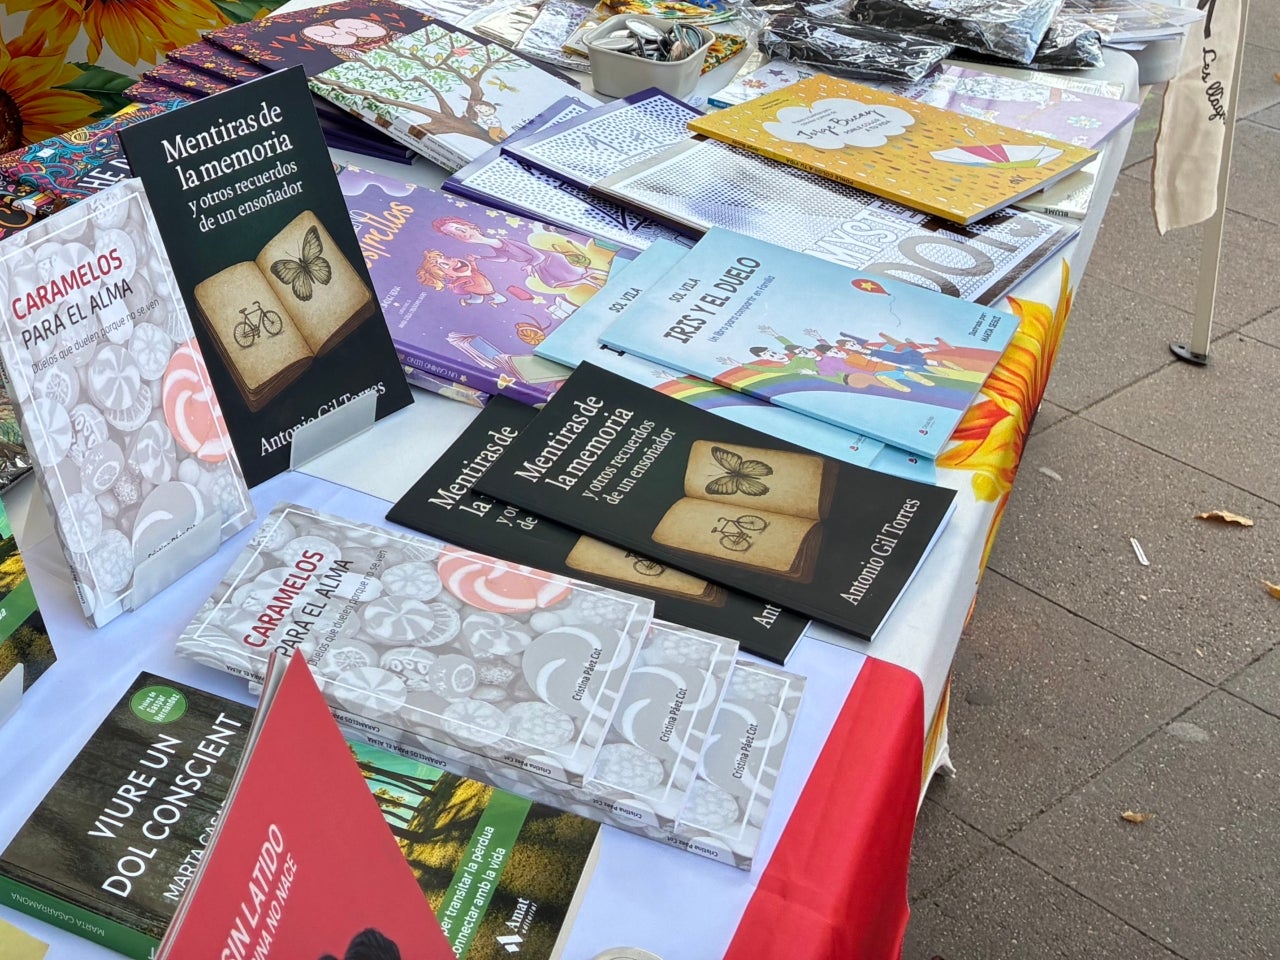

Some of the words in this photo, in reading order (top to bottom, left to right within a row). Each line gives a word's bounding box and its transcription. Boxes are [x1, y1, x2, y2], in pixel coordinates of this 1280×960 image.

[161, 112, 258, 164] Mentiras
[259, 101, 283, 128] de
[796, 122, 839, 140] Jorge
[175, 165, 198, 191] la
[199, 130, 294, 184] memoria
[187, 199, 197, 218] y
[199, 185, 234, 212] otros
[234, 159, 298, 195] recuerdos
[198, 213, 216, 233] de
[217, 208, 237, 226] un
[237, 178, 304, 215] ensoñador
[1043, 206, 1069, 218] BLUME
[11, 247, 123, 321] CARAMELOS
[712, 256, 762, 294] DUELO
[608, 300, 626, 314] SOL
[621, 286, 644, 306] VILA
[668, 291, 683, 304] SOL
[678, 277, 702, 297] VILA
[699, 292, 732, 308] EL
[21, 314, 66, 350] PARA
[67, 302, 88, 326] EL
[89, 278, 134, 315] ALMA
[690, 304, 716, 316] Y
[708, 331, 719, 343] Un
[717, 323, 728, 338] libro
[725, 315, 737, 333] para
[734, 294, 757, 319] compartir
[755, 288, 764, 299] en
[31, 351, 58, 375] Duelos
[58, 344, 73, 360] que
[73, 330, 100, 351] duelen
[100, 315, 126, 341] porque
[126, 310, 137, 323] no
[146, 298, 160, 314] ven
[663, 314, 707, 344] IRIS
[981, 327, 995, 343] MARTA
[514, 412, 589, 483] Mentiras
[579, 393, 604, 417] de
[544, 471, 578, 491] la
[566, 405, 634, 481] memoria
[609, 418, 656, 467] recuerdos
[428, 439, 503, 511] Mentiras
[491, 424, 519, 448] de
[589, 463, 618, 490] otros
[602, 487, 624, 505] de
[616, 474, 636, 491] un
[628, 427, 677, 478] ensoñador
[459, 498, 492, 518] la
[581, 488, 600, 501] y
[495, 513, 514, 527] y
[516, 514, 538, 531] de
[883, 497, 921, 539] Torres
[375, 549, 388, 563] ven
[870, 533, 898, 558] Gil
[364, 568, 375, 580] no
[369, 558, 380, 571] se
[314, 558, 354, 602] ALMA
[348, 578, 370, 607] porque
[839, 558, 885, 606] Antonio
[243, 548, 325, 649] CARAMELOS
[301, 602, 328, 618] EL
[334, 602, 354, 630] duelen
[274, 617, 312, 658] PARA
[325, 626, 340, 643] que
[306, 639, 330, 668] Duelos
[583, 657, 598, 676] Páez
[590, 647, 603, 660] Cot
[571, 671, 592, 702] Cristina
[675, 687, 688, 701] Cot
[146, 693, 167, 714] Gaspar
[669, 697, 683, 716] Páez
[349, 720, 380, 733] CARAMELOS
[659, 712, 679, 743] Cristina
[745, 723, 759, 737] Cot
[393, 744, 410, 757] PARA
[410, 749, 447, 767] CARAMELOS
[740, 734, 755, 753] Páez
[731, 749, 750, 780] Cristina
[87, 769, 157, 839] VIURE
[139, 733, 183, 769] UN
[101, 846, 158, 898] DOL
[141, 712, 243, 840] CONSCIENT
[445, 872, 474, 917] transitar
[463, 861, 478, 873] la
[471, 825, 495, 863] pèrdua
[488, 846, 506, 869] vida
[162, 848, 203, 902] MARTA
[241, 823, 284, 929] LATIDO
[482, 869, 496, 882] la
[11, 891, 76, 924] CASARRAMONA
[266, 900, 282, 934] NO
[275, 852, 298, 907] NACE
[473, 881, 491, 907] amb
[75, 917, 105, 937] MARTA
[505, 897, 530, 932] Amat
[521, 902, 538, 934] editorial
